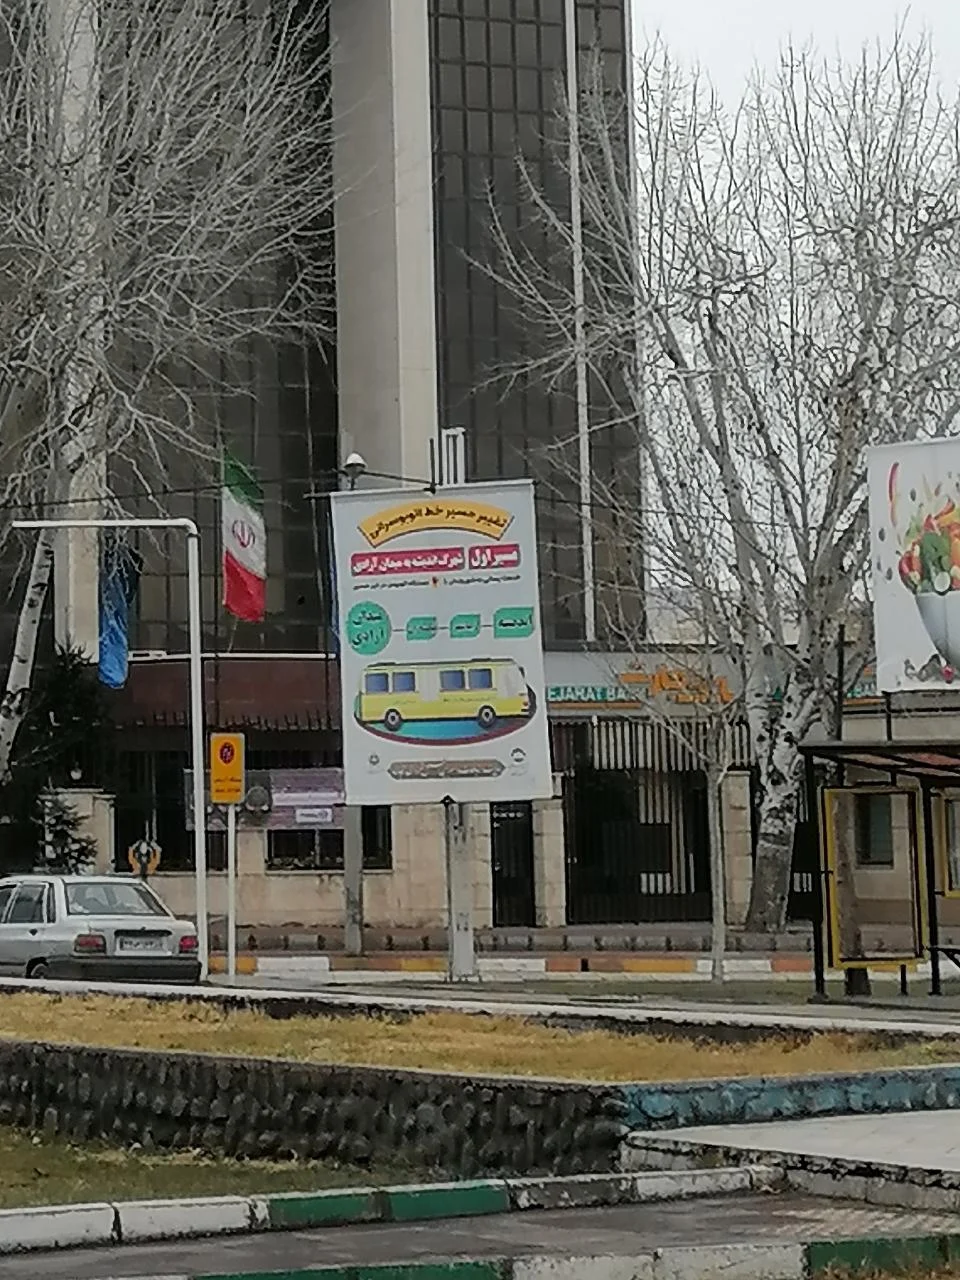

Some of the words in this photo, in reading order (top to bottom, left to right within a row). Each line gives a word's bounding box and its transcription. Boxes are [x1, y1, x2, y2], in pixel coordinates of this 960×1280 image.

[424, 505, 443, 516] خط
[470, 548, 491, 568] اول
[547, 686, 607, 701] EJARAT
